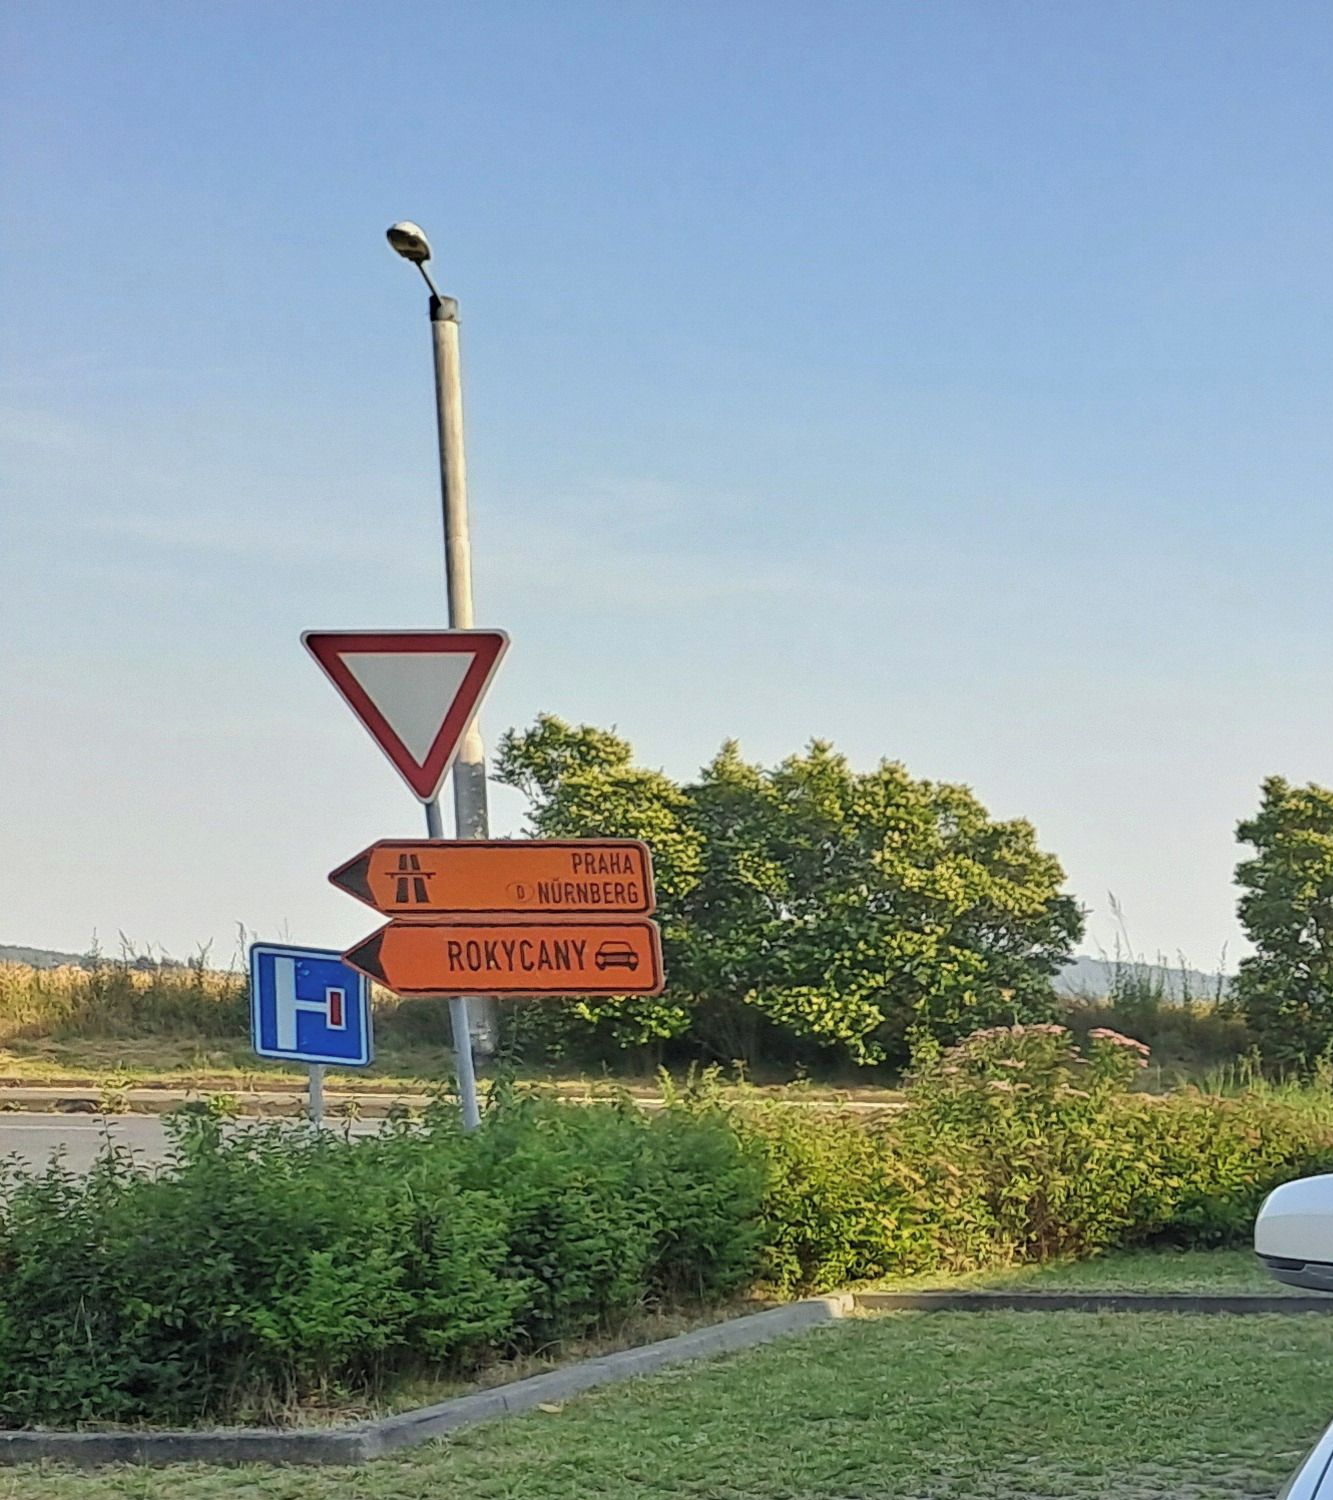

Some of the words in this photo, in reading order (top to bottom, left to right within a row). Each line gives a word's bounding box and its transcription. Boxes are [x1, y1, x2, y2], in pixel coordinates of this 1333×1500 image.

[571, 852, 635, 875] PRAHA
[516, 884, 526, 900] D
[537, 877, 639, 904] NÜRNBERG
[447, 939, 587, 972] ROKYCANY
